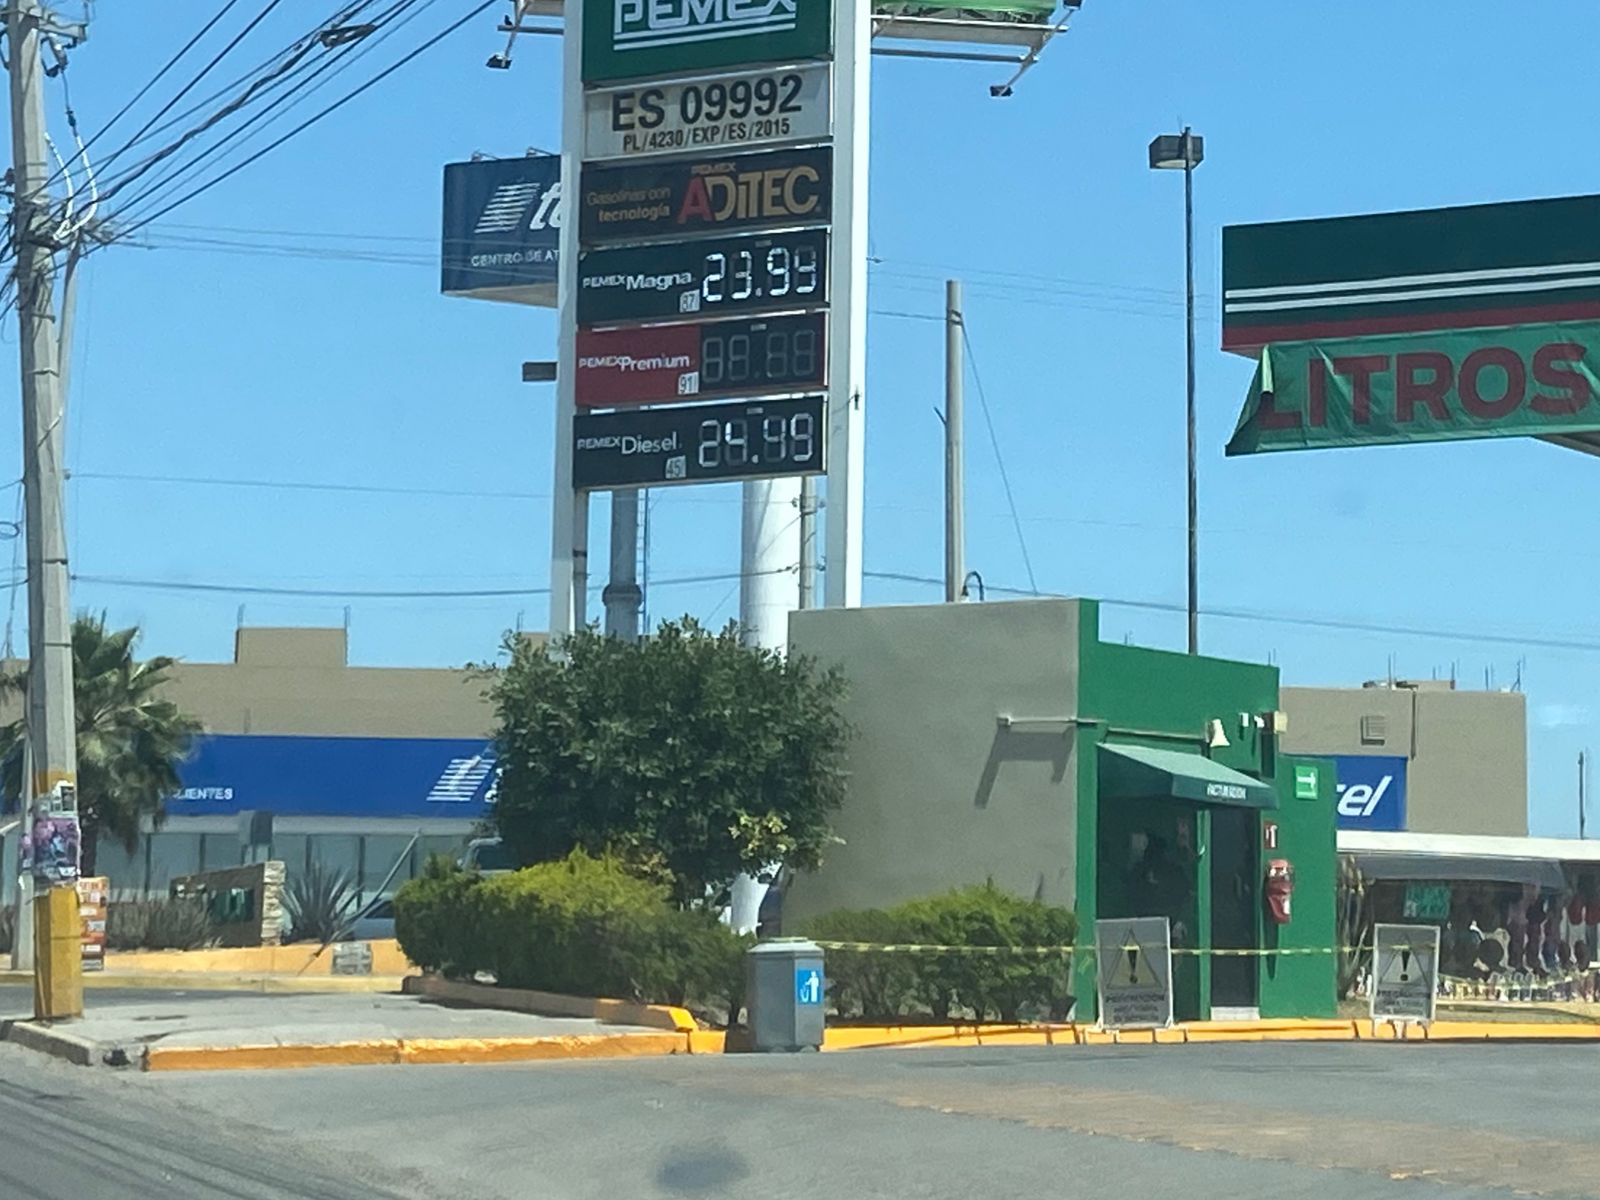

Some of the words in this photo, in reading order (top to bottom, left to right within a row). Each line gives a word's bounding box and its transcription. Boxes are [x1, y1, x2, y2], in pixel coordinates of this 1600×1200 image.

[612, 88, 665, 132] ES
[680, 74, 803, 125] 09992
[586, 188, 648, 206] Gasolinas
[649, 186, 671, 200] con
[598, 202, 671, 223] tecnología
[471, 252, 523, 267] CENTRO
[626, 272, 692, 291] Magna
[702, 247, 816, 302] 23.99
[619, 353, 690, 372] Premium
[1256, 342, 1591, 431] LITROS
[621, 431, 677, 455] Diesel
[698, 412, 813, 468] 24.49
[171, 787, 233, 800] LIENTES
[1336, 775, 1393, 816] el
